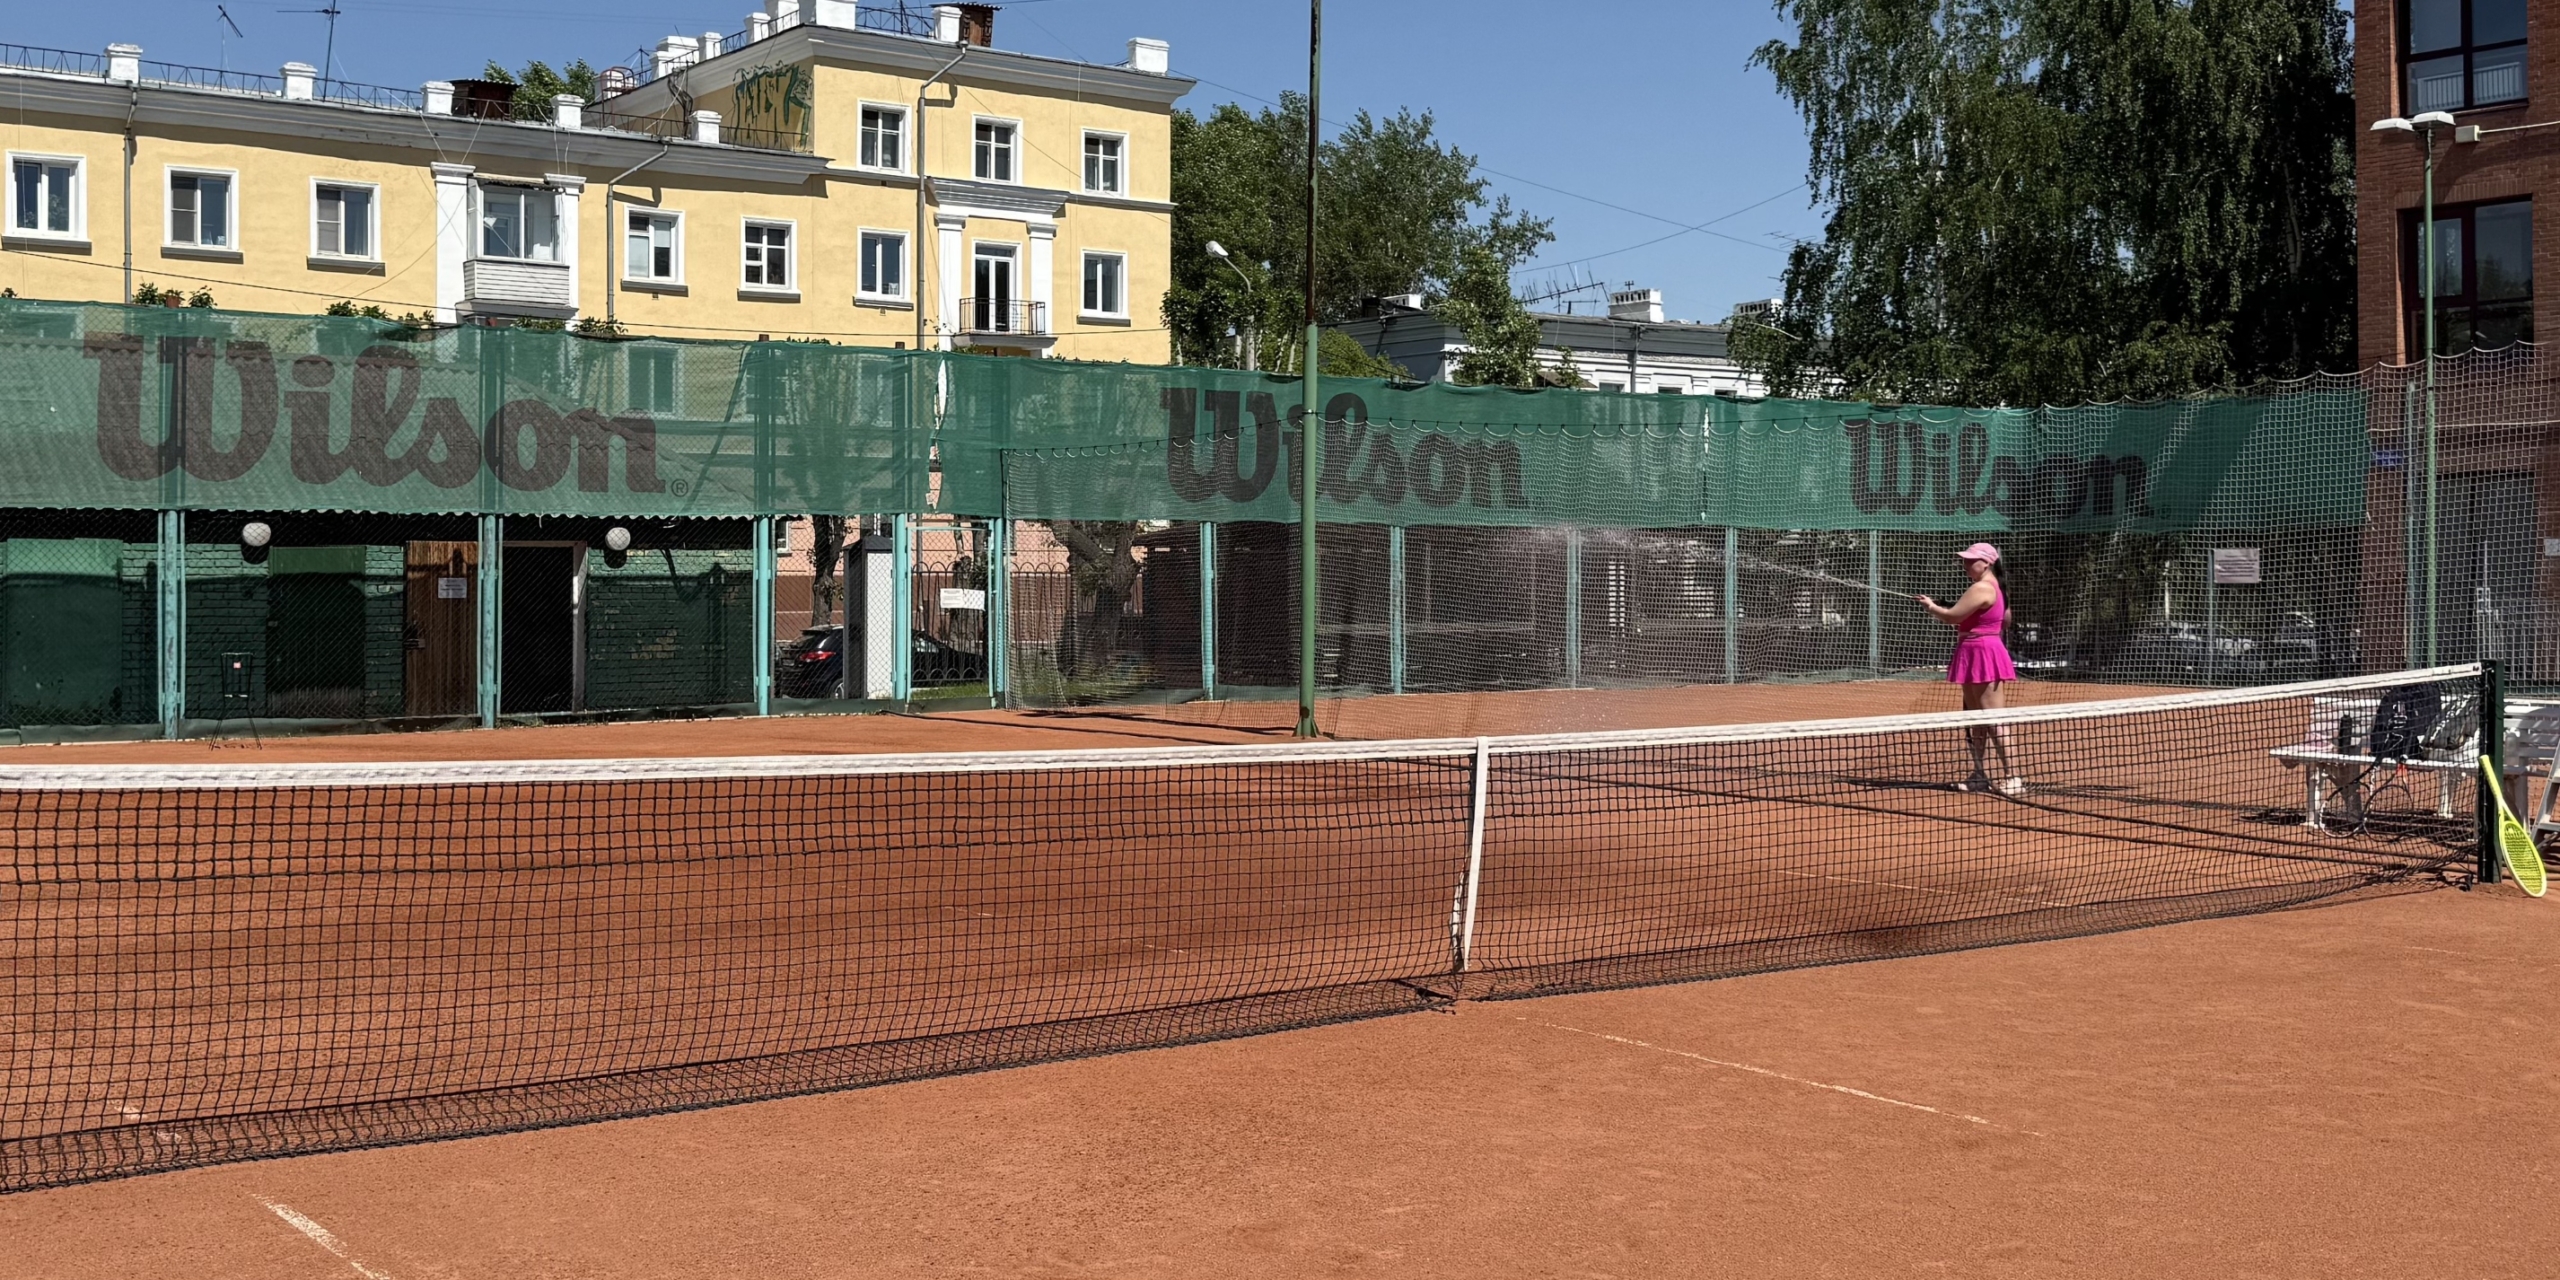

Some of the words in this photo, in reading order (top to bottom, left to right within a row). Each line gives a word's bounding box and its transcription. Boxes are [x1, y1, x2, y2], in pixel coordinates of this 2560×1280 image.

[82, 331, 667, 493] Wilson
[1160, 387, 1530, 510] Wilson
[1844, 418, 2155, 518] Wilson
